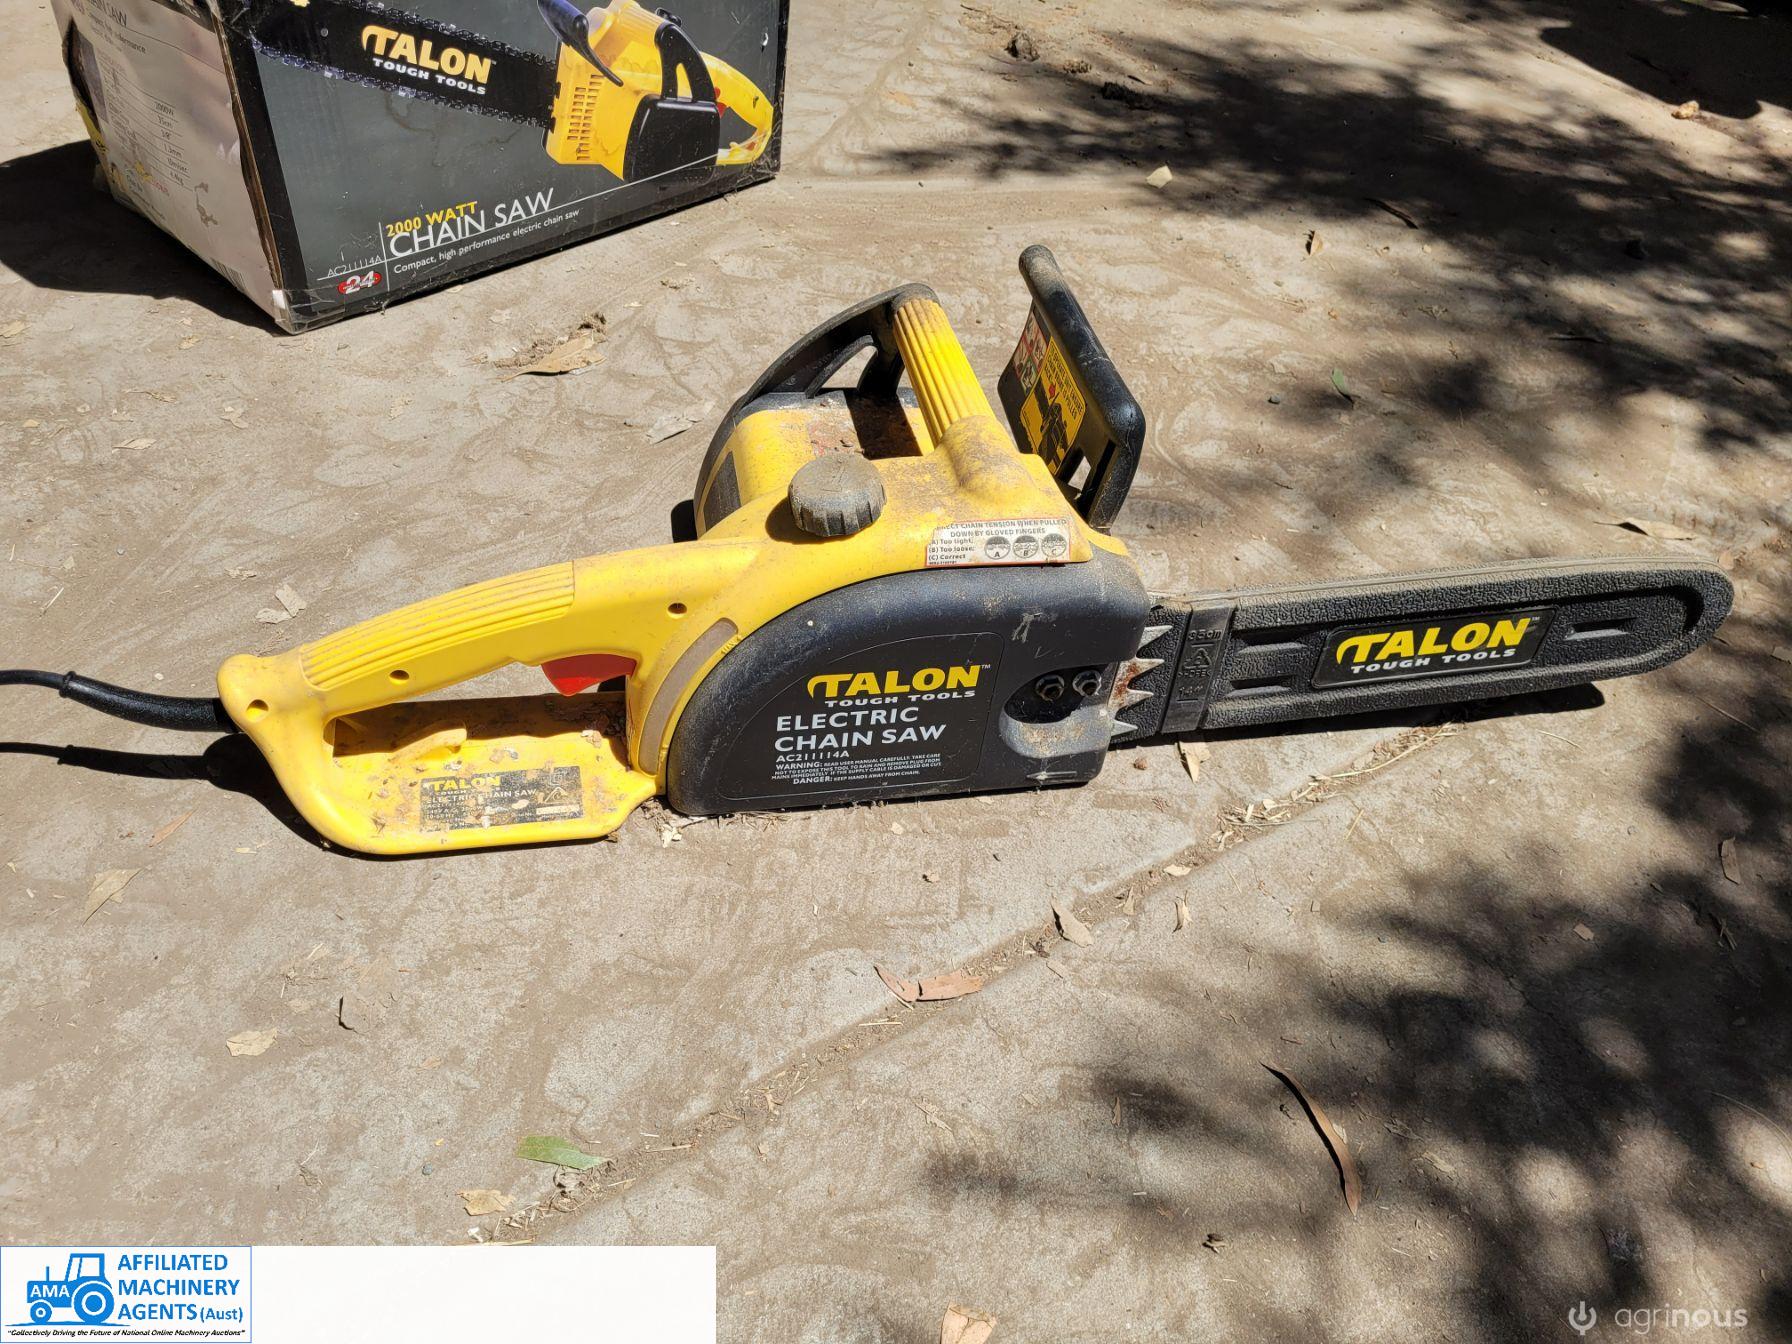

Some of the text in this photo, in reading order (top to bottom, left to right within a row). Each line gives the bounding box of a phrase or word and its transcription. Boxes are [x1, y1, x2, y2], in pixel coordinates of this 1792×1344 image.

[362, 25, 492, 84] TALON
[372, 57, 486, 95] TOUGH TOOLS
[386, 201, 478, 237] 2000 WATT
[390, 187, 554, 257] CHAIN SAW
[394, 209, 580, 274] Compact, high performance electric chain saw
[345, 271, 377, 294] 24
[950, 530, 974, 538] DOWN
[1016, 527, 1046, 535] FINGERS
[984, 520, 1016, 528] TENSION
[1336, 617, 1532, 665] TALON
[1351, 648, 1517, 674] TOUGH TOOLS
[807, 664, 982, 699] TALON
[824, 690, 976, 708] TOUGH TOOLS
[776, 706, 919, 732] ELECTRIC
[774, 724, 947, 751] CHAIN SAW
[776, 751, 849, 762] AC211114A
[776, 761, 823, 771] WARNING:
[427, 776, 501, 792] TALON
[515, 788, 537, 798] SAW
[793, 775, 833, 785] DANGER:
